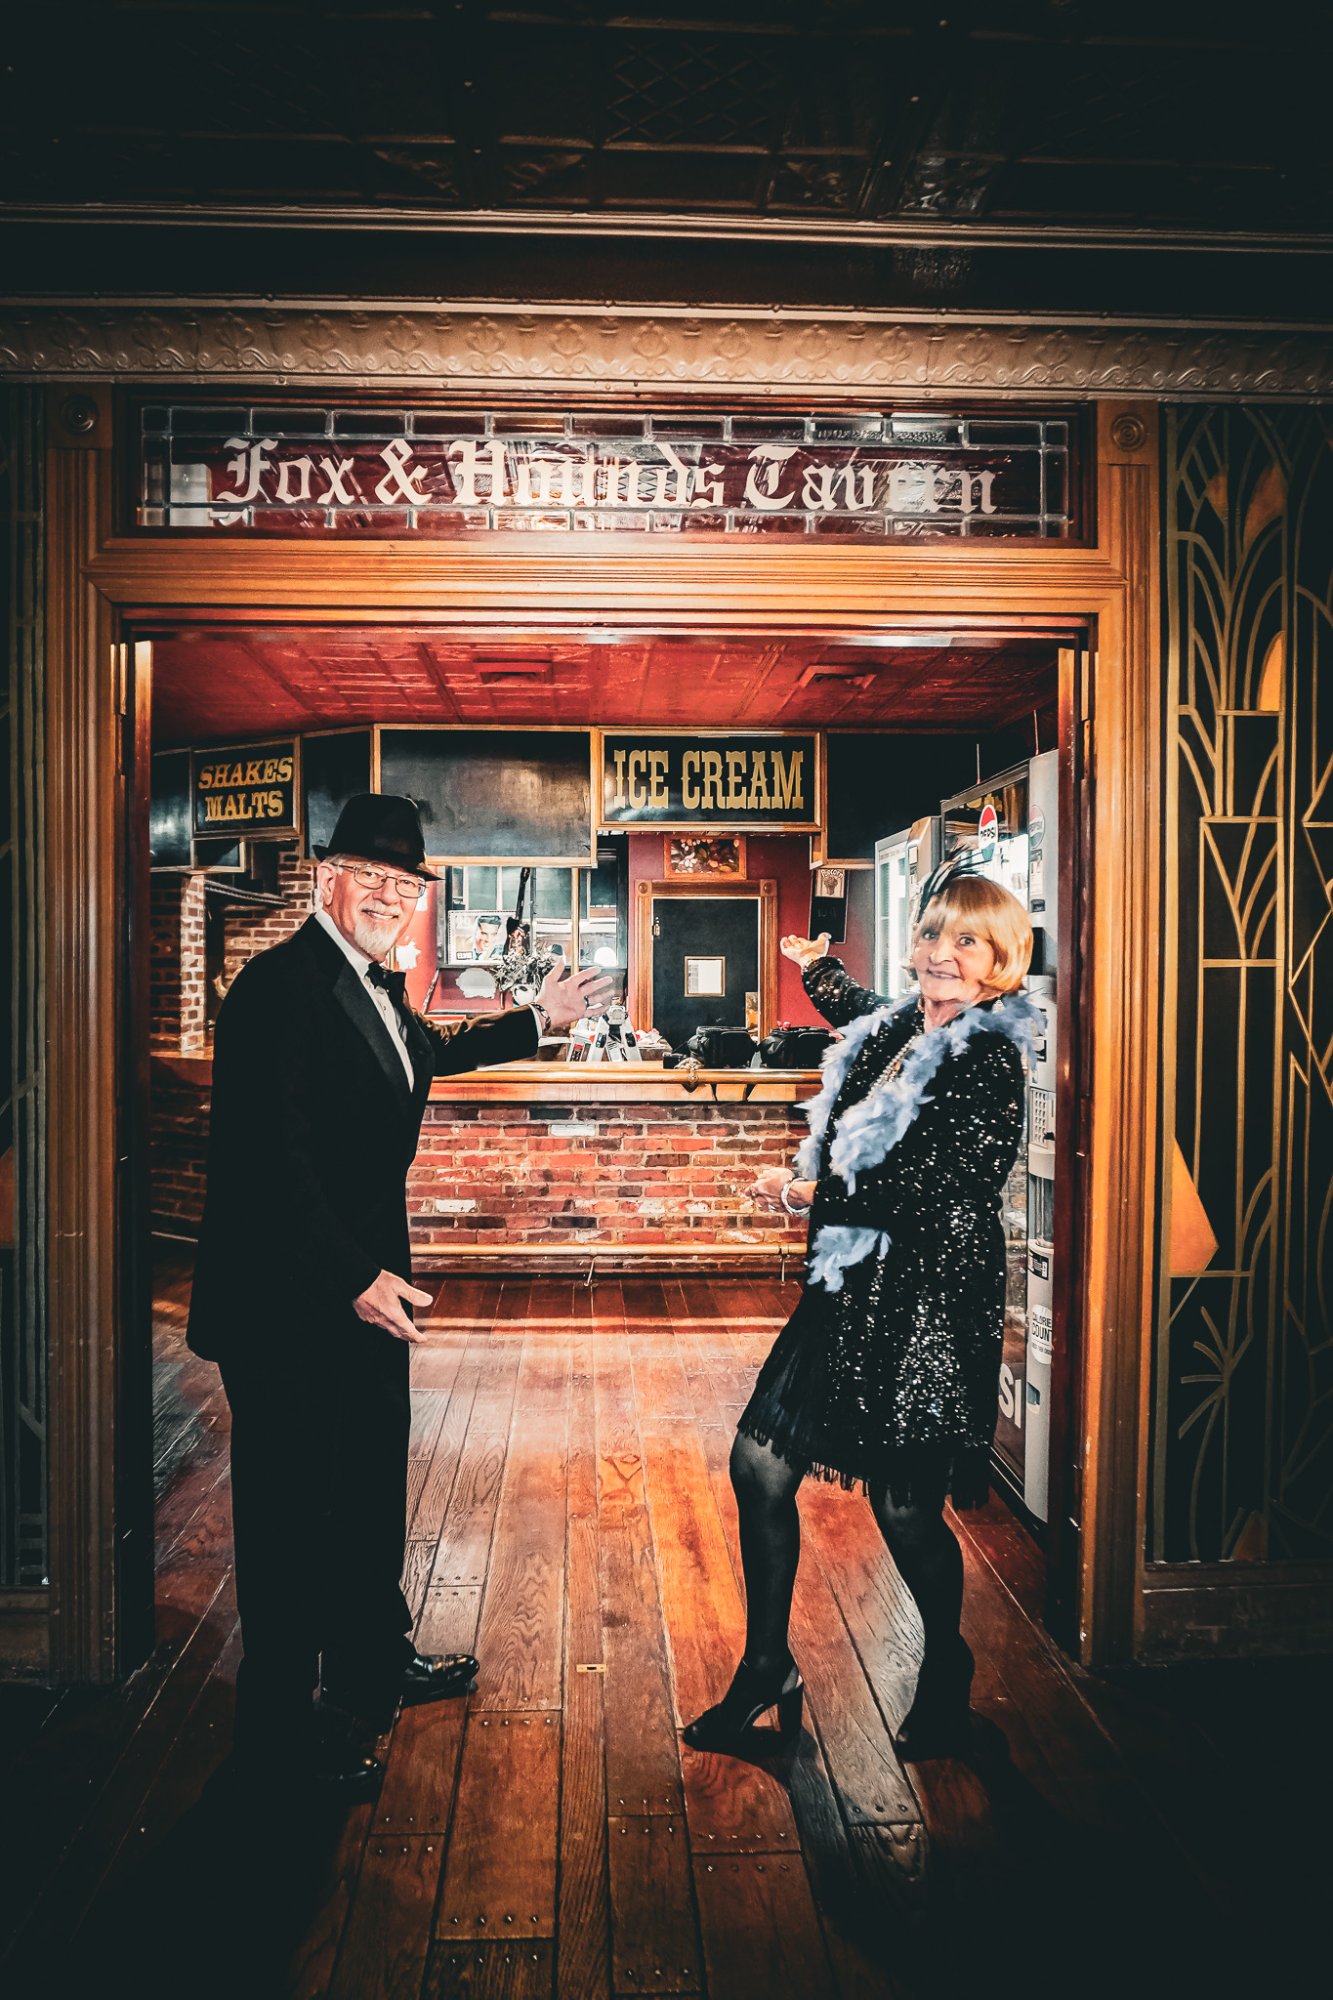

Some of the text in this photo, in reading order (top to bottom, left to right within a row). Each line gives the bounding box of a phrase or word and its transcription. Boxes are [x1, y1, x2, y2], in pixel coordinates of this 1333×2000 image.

[217, 438, 998, 514] Fox & Hounds Tavern
[198, 757, 293, 789] SHAKES
[613, 750, 804, 809] ICE CREAM
[205, 790, 283, 822] MALTS
